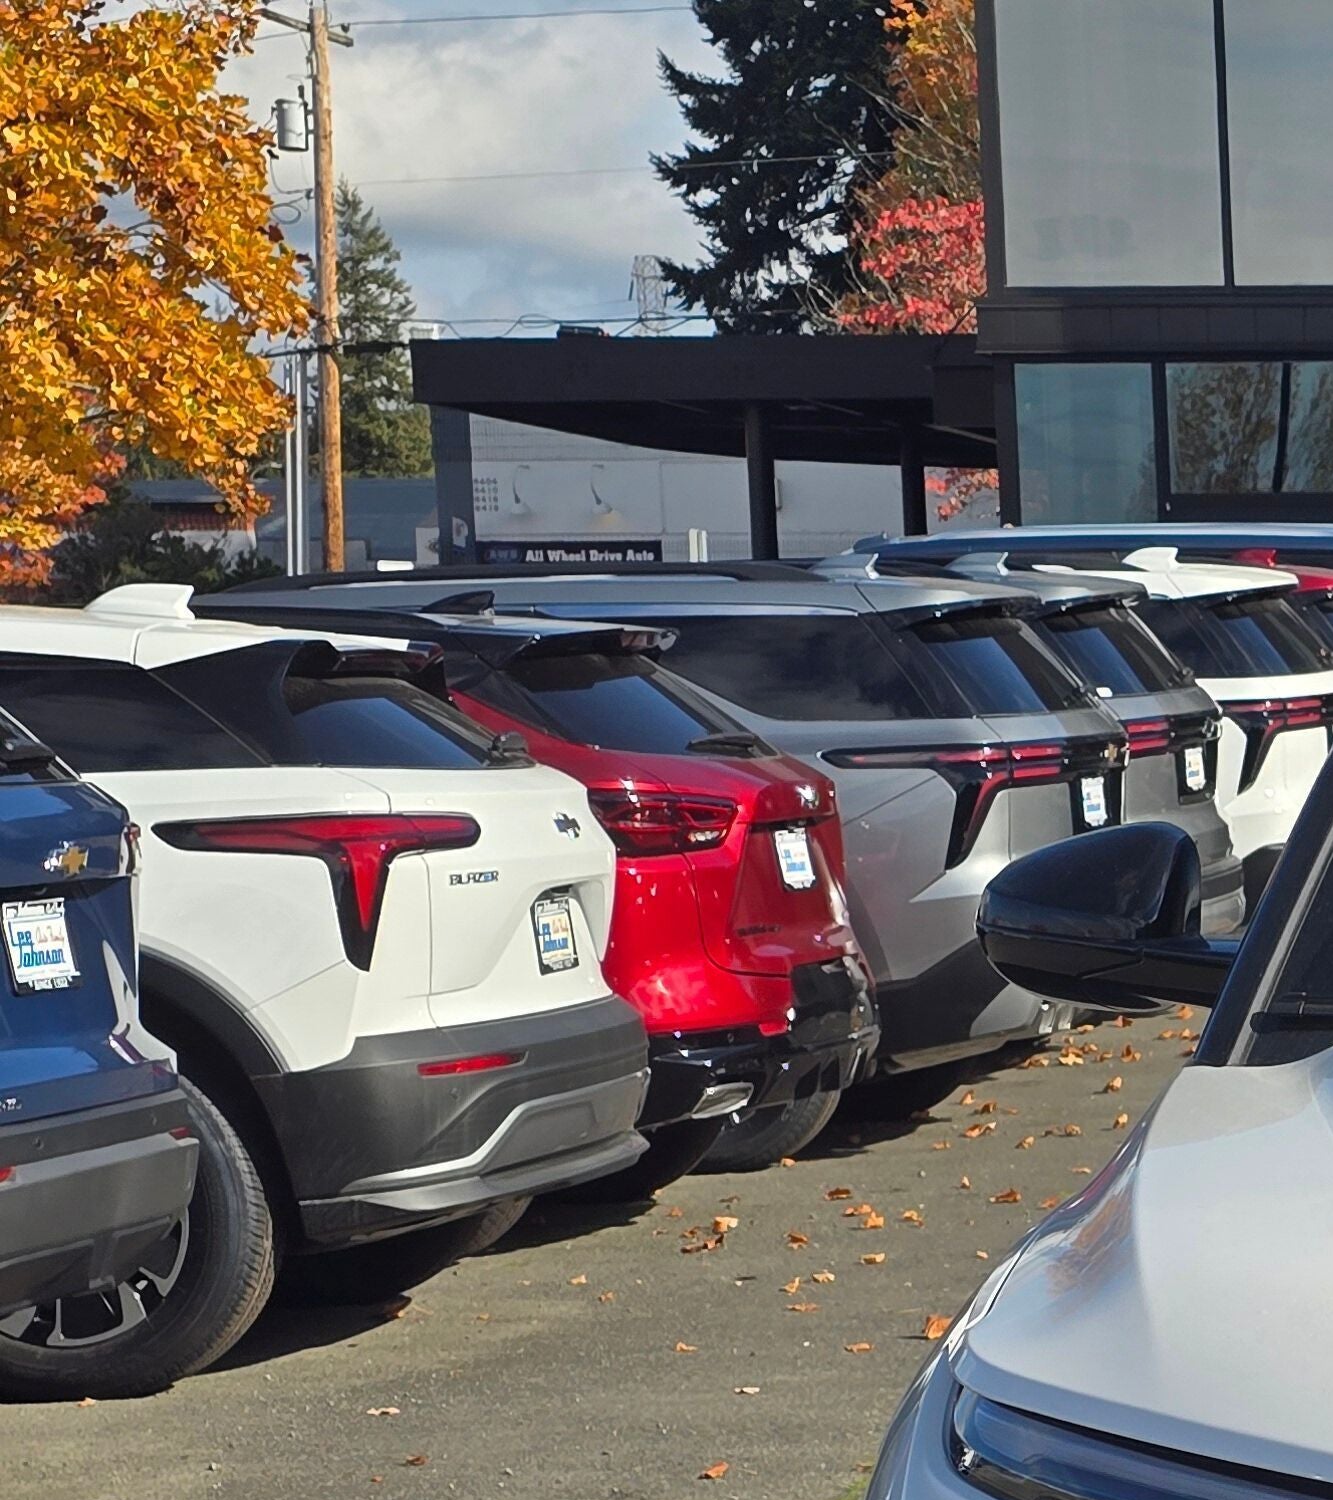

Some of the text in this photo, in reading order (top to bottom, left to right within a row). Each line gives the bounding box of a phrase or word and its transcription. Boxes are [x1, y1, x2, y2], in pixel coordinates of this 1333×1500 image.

[525, 549, 544, 562] All
[547, 549, 586, 562] Wheel
[589, 549, 623, 562] Drive
[626, 549, 655, 562] Auto
[449, 870, 499, 886] BLAZER
